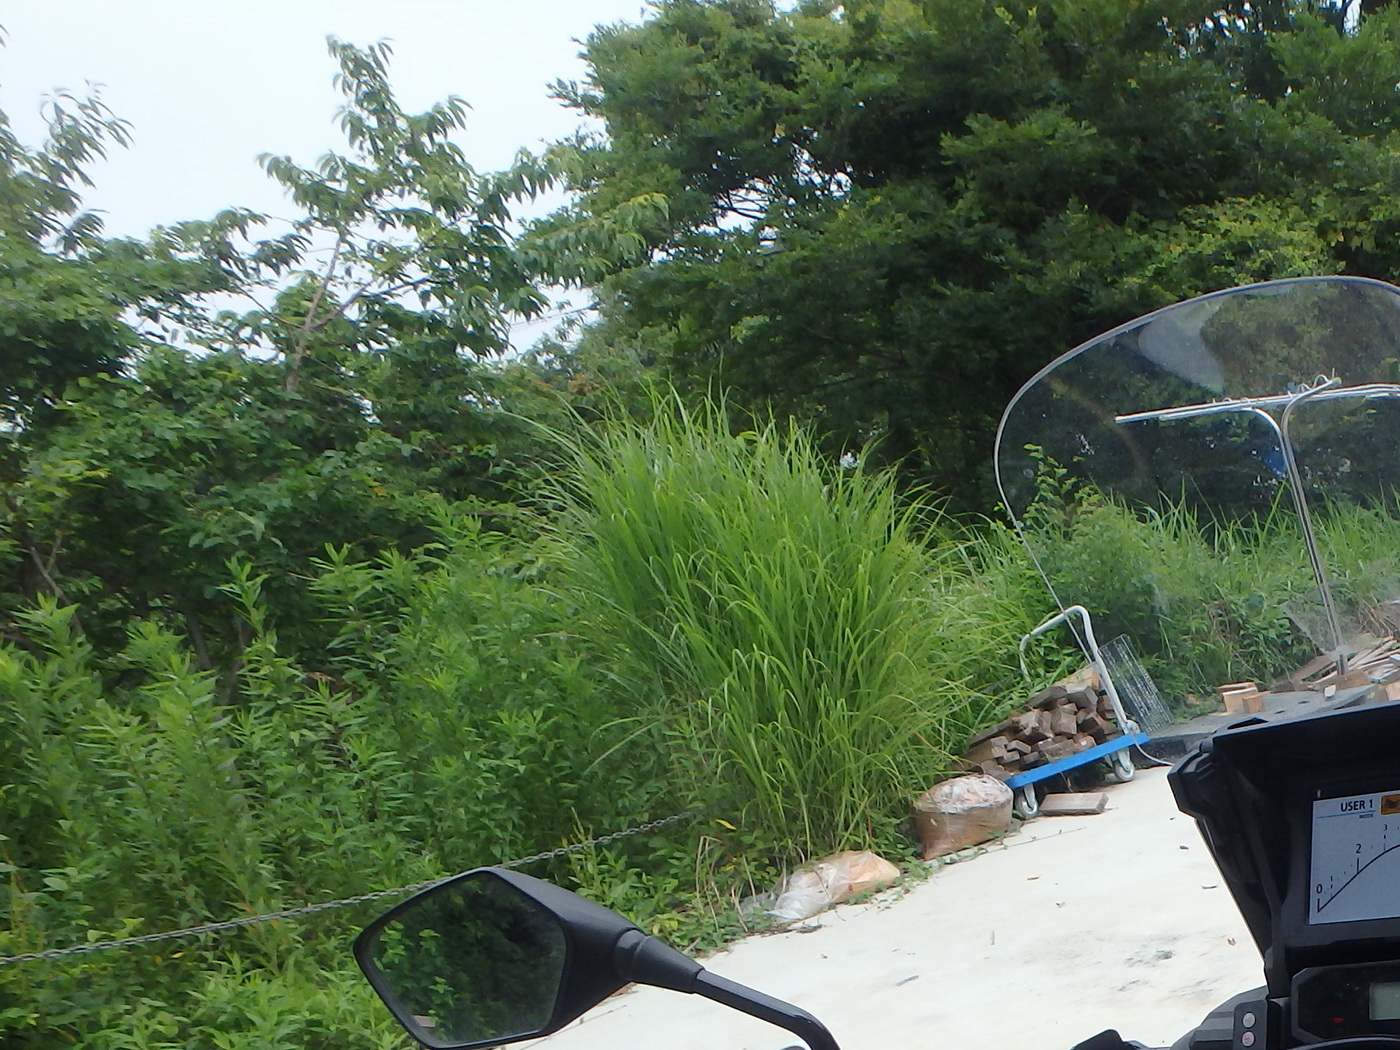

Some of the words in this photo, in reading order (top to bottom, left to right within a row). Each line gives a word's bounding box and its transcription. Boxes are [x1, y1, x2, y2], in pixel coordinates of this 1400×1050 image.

[1341, 800, 1365, 812] USER
[1369, 799, 1373, 808] 1
[1355, 843, 1362, 854] 2
[1316, 884, 1323, 894] 0
